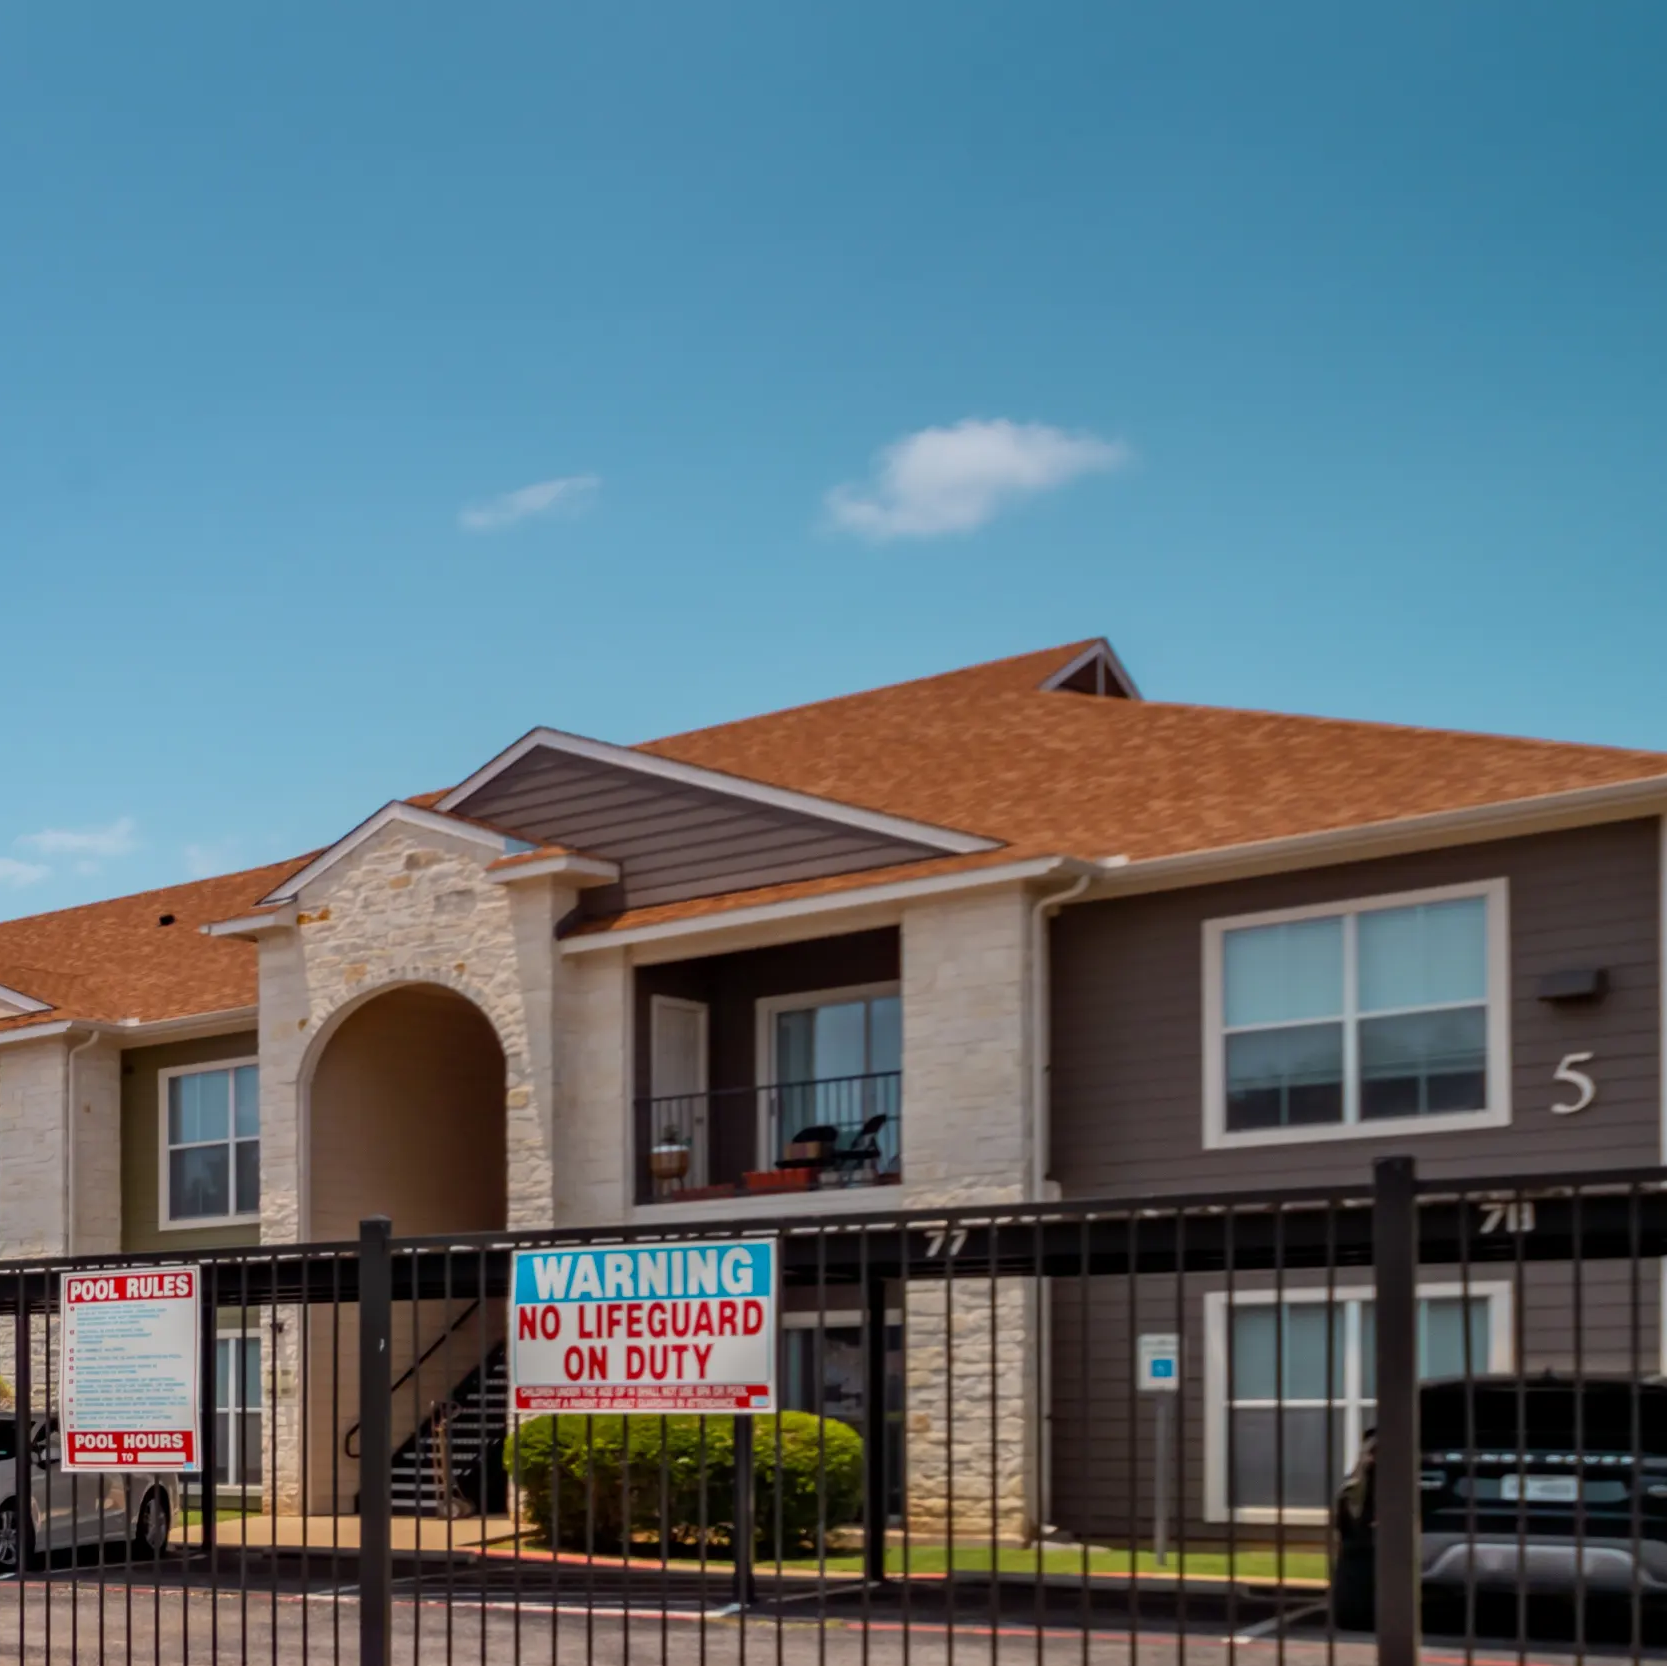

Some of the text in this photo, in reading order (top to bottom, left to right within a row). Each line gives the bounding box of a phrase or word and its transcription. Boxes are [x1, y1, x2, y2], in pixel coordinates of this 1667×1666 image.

[1551, 1052, 1596, 1115] 5
[925, 1230, 967, 1257] 77
[533, 1247, 753, 1300] WARNING
[70, 1275, 189, 1301] POOL RULES
[519, 1300, 764, 1340] NO LIFEGUARD
[565, 1344, 713, 1381] ON DUTY
[521, 1387, 555, 1397] CHILDREN
[557, 1387, 581, 1397] UNDER
[530, 1398, 561, 1408] WITHOUT
[75, 1434, 184, 1448] POOL HOURS
[122, 1452, 133, 1461] TO
[1445, 1453, 1533, 1463] RNGE
